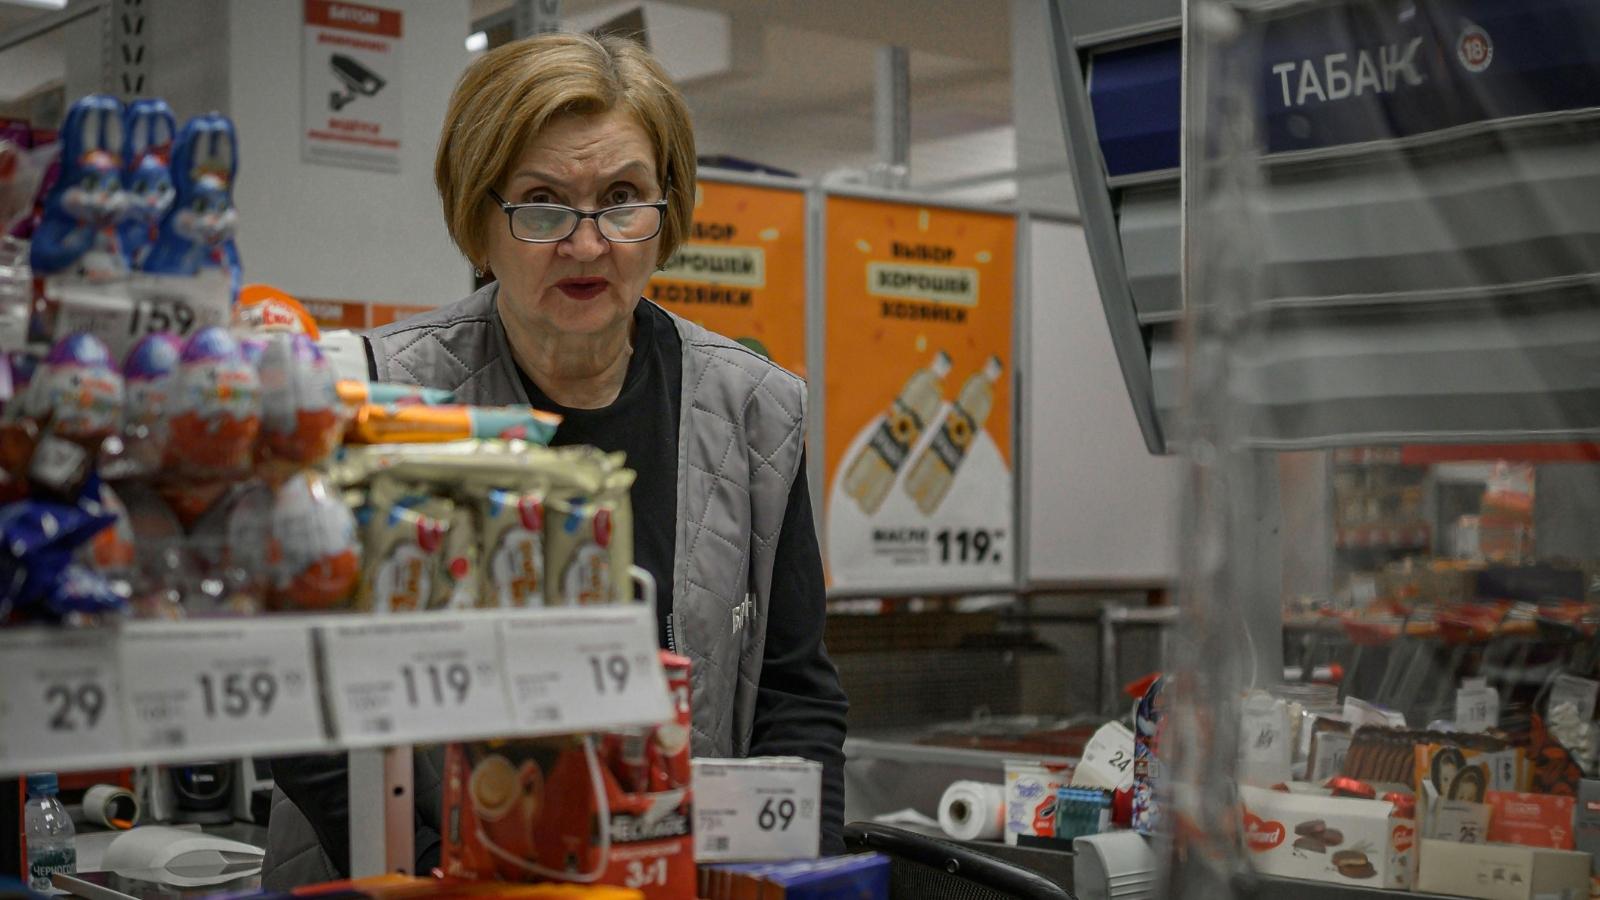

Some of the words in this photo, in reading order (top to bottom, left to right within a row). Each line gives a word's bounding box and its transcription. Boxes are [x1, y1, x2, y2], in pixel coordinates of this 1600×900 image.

[1272, 37, 1424, 107] ТАБАК
[693, 222, 736, 241] БОР
[891, 240, 954, 261] ВЫБОР
[878, 268, 970, 294] ХОРОШЕЙ
[127, 301, 196, 336] 159
[400, 663, 471, 706] 119
[588, 654, 631, 695] 19
[46, 682, 105, 732] 29
[198, 671, 278, 719] 159
[1108, 751, 1132, 774] 24
[758, 798, 796, 832] 69
